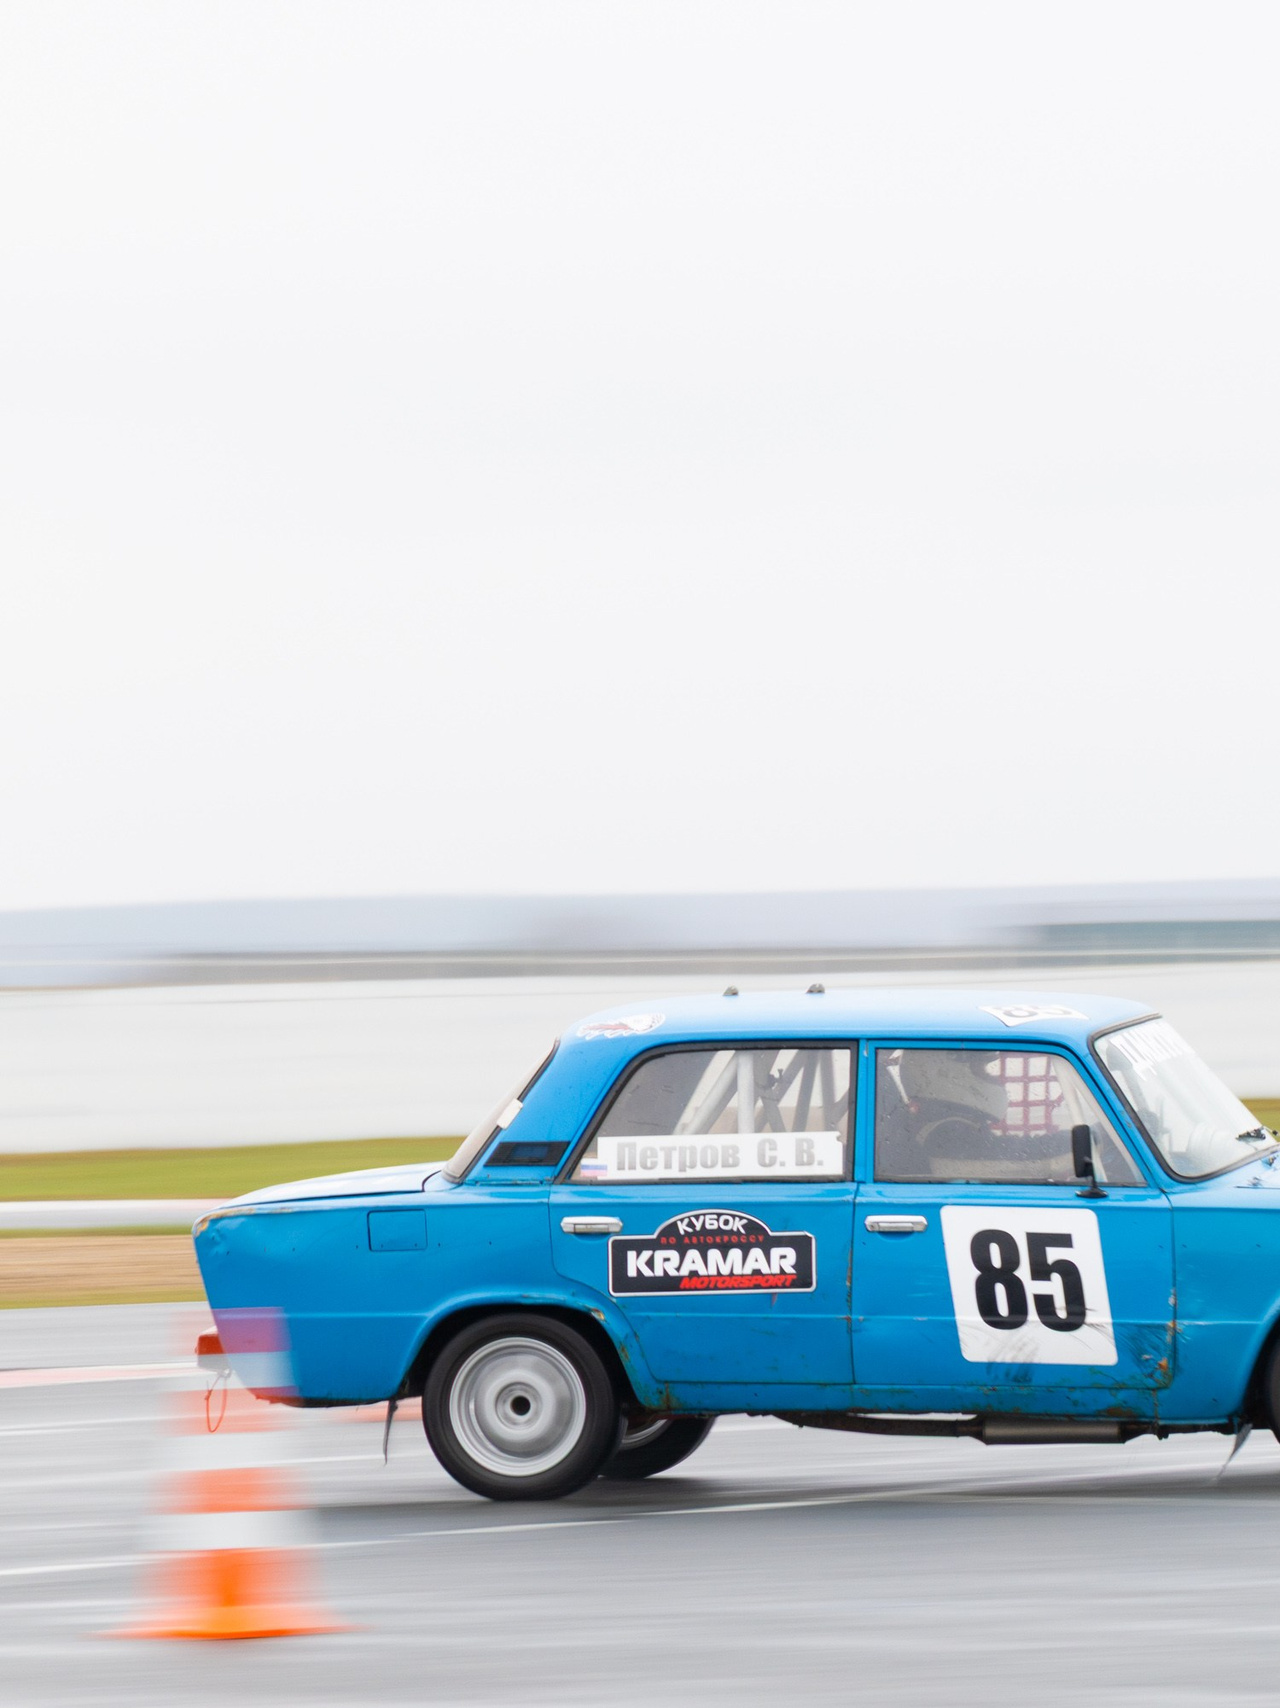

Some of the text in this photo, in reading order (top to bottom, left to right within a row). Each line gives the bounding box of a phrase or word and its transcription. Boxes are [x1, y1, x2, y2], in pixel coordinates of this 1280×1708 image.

[616, 1141, 741, 1173] Петров
[795, 1137, 824, 1167] В.
[677, 1214, 748, 1235] КУБОК
[627, 1247, 797, 1277] KRAMAR
[680, 1275, 797, 1289] MOTORSPORT
[970, 1229, 1087, 1332] 85
